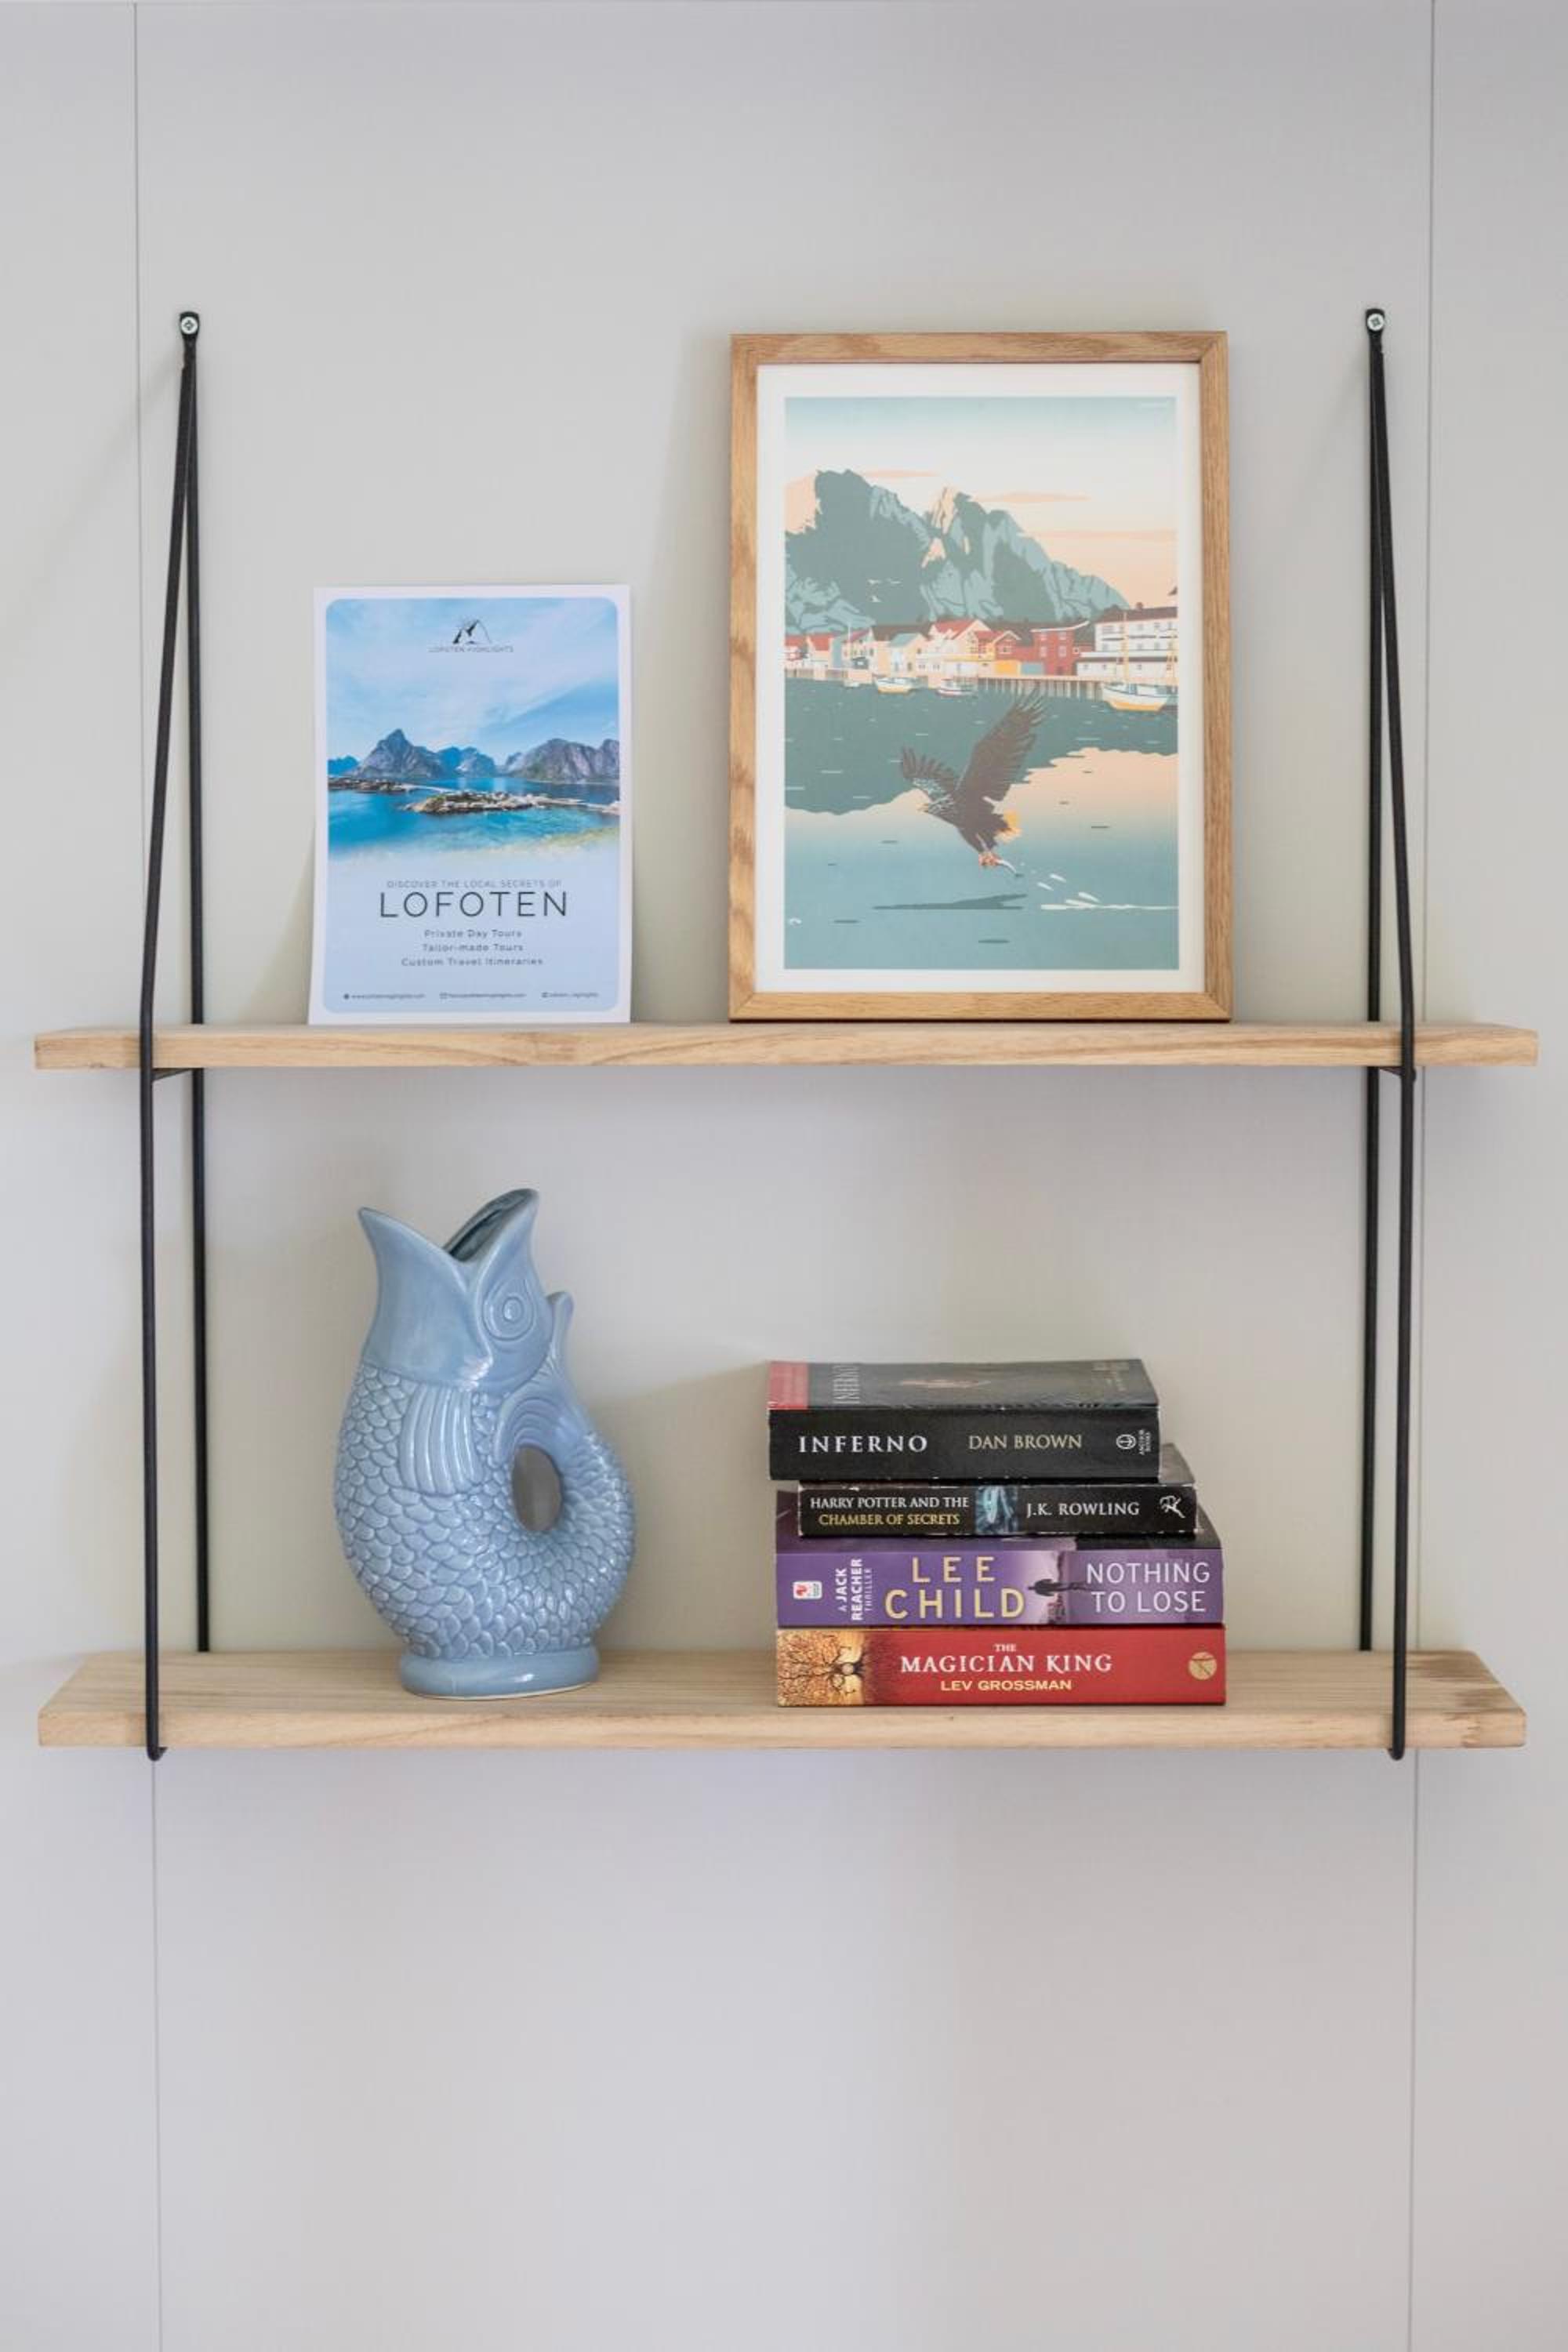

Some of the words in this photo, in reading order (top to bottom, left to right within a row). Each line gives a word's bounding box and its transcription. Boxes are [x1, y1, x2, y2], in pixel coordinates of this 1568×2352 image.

[387, 879, 437, 889] DISCOVER
[442, 879, 459, 888] THE
[464, 879, 496, 888] LOCAL
[501, 879, 545, 888] SECRETS
[547, 879, 562, 887] OF
[380, 891, 567, 917] LOFOTEN
[424, 929, 463, 938] Private
[467, 929, 488, 939] Day
[492, 929, 522, 938] Tours
[423, 943, 489, 952] Tailor-made
[493, 943, 524, 952] Tours
[401, 958, 444, 967] Custom
[448, 957, 482, 966] Travel
[485, 957, 543, 966] Itineraries
[798, 1436, 927, 1453] INFERNO
[968, 1435, 1007, 1450] DAN
[1014, 1434, 1083, 1450] BROWN
[810, 1497, 854, 1509] HARRY
[858, 1497, 907, 1508] POTTER
[909, 1497, 939, 1508] AND
[942, 1497, 969, 1508] THE
[1027, 1503, 1052, 1518] J.K.
[1058, 1502, 1140, 1515] ROWLING
[818, 1514, 884, 1525] CHAMBER
[886, 1514, 903, 1525] OF
[906, 1514, 960, 1525] SECRETS
[912, 1556, 996, 1583] LEE
[1087, 1562, 1210, 1584] NOTHING
[835, 1568, 848, 1602] JACK
[851, 1559, 862, 1621] REACHER
[864, 1568, 873, 1611] THRILLER
[837, 1604, 848, 1613] A
[885, 1588, 1025, 1619] CHILD
[1091, 1591, 1126, 1613] TO
[1138, 1591, 1205, 1613] LOSE
[994, 1643, 1017, 1652] THE
[902, 1655, 1035, 1672] MAGICIAN
[1047, 1653, 1112, 1674] KING
[941, 1680, 973, 1691] LEV
[978, 1680, 1072, 1691] GROSSMAN
